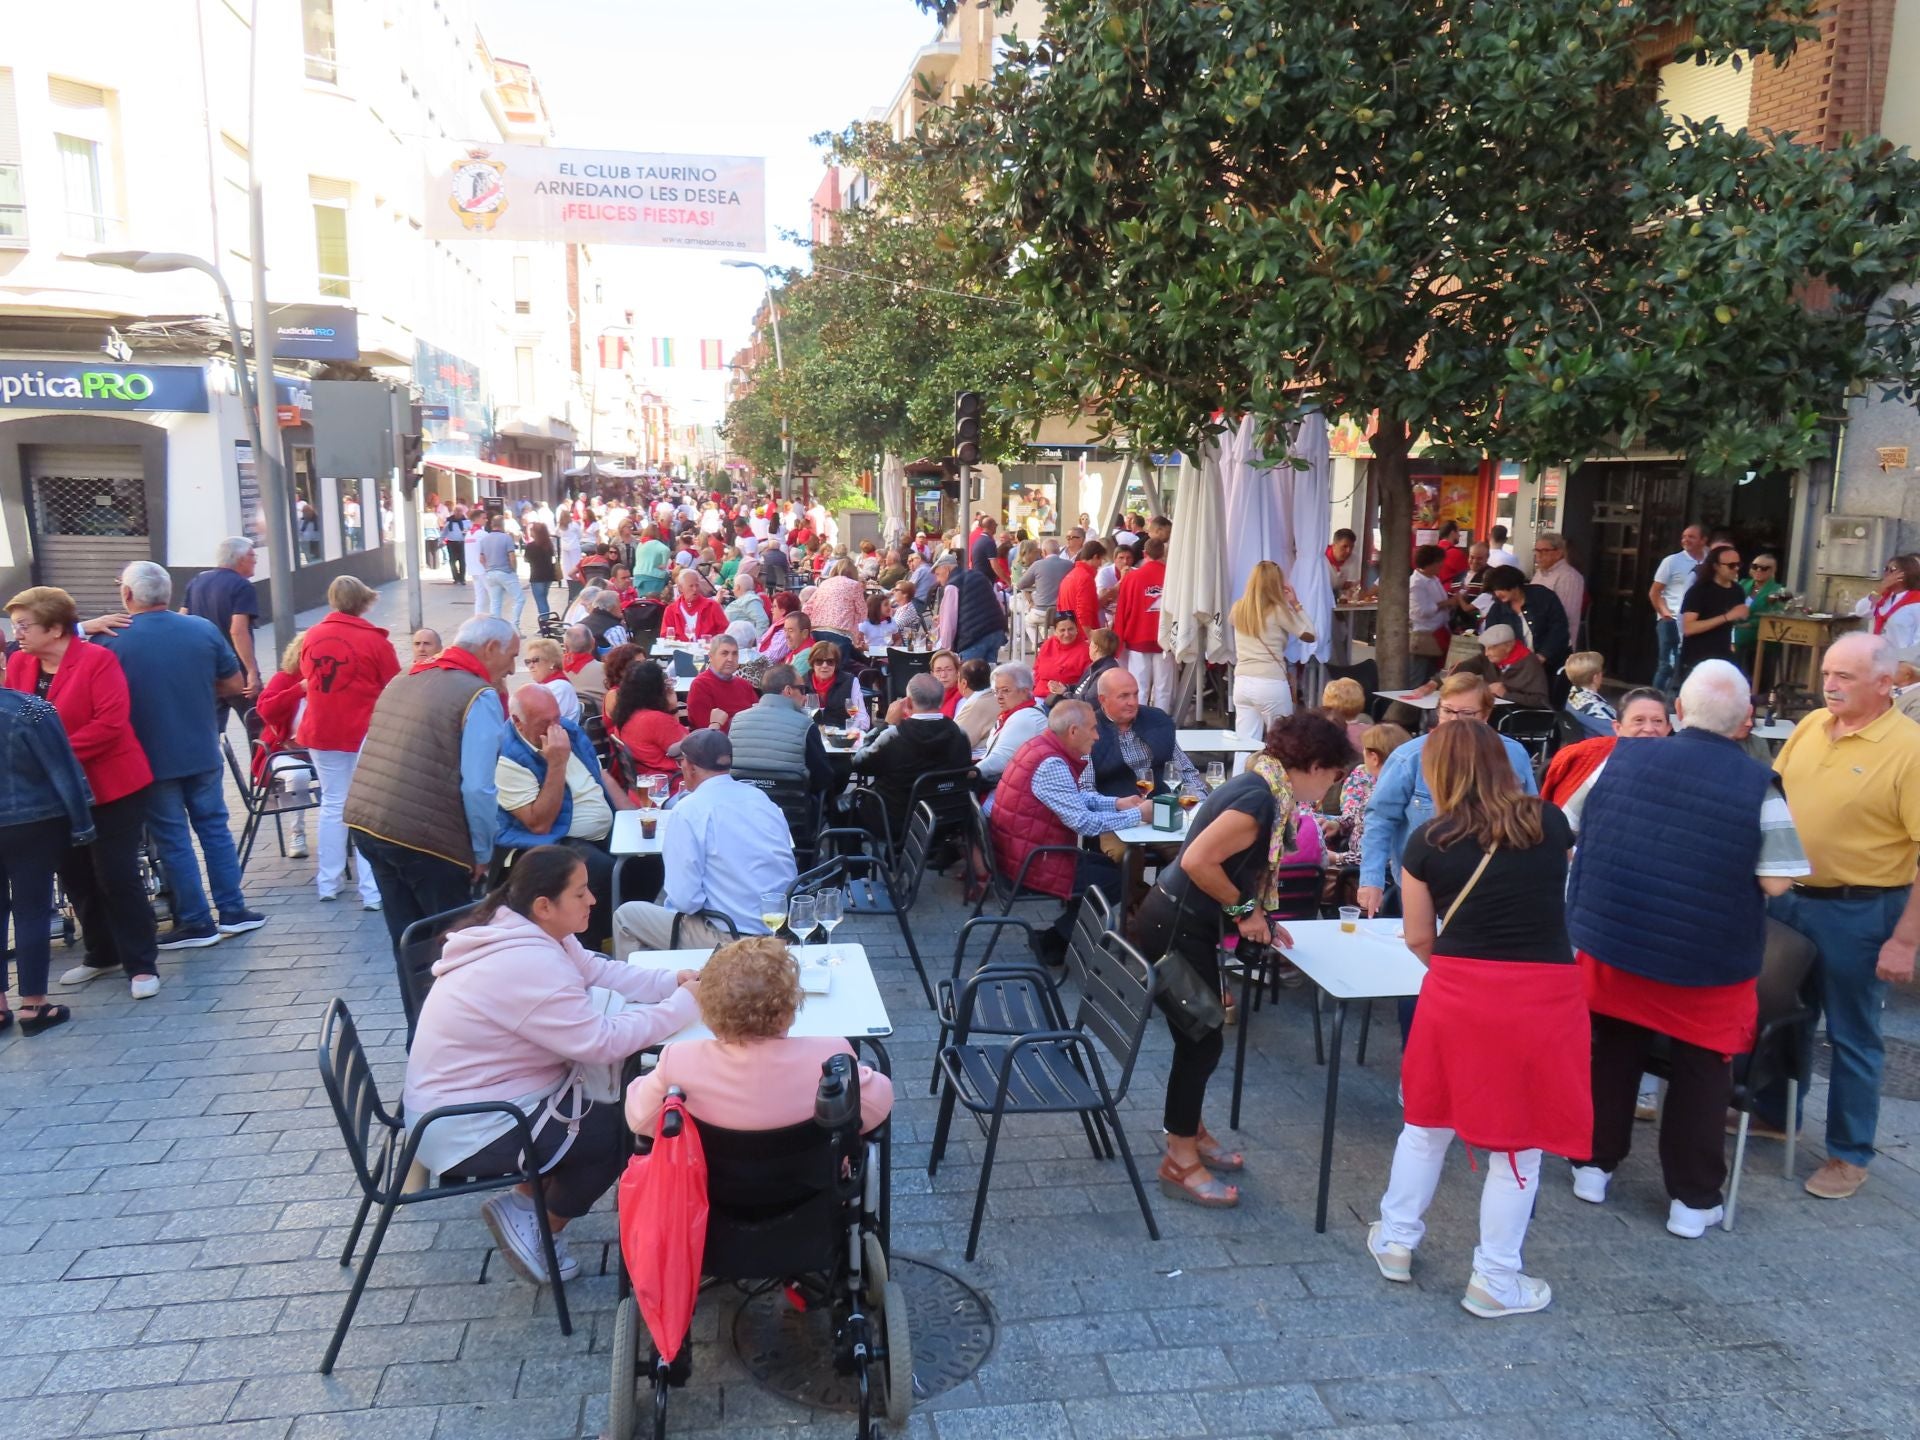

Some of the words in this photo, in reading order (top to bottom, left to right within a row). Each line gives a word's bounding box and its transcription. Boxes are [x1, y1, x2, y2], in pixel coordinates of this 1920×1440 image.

[559, 163, 577, 177] EL
[583, 164, 632, 179] CLUB
[636, 166, 717, 182] TAURINO
[533, 180, 644, 199] ARNEDANO
[650, 185, 679, 202] LES
[685, 188, 741, 206] DESEA
[562, 203, 638, 222] ¡FELICES
[643, 207, 715, 226] FIESTAS!
[0, 370, 154, 403] pticaPRO
